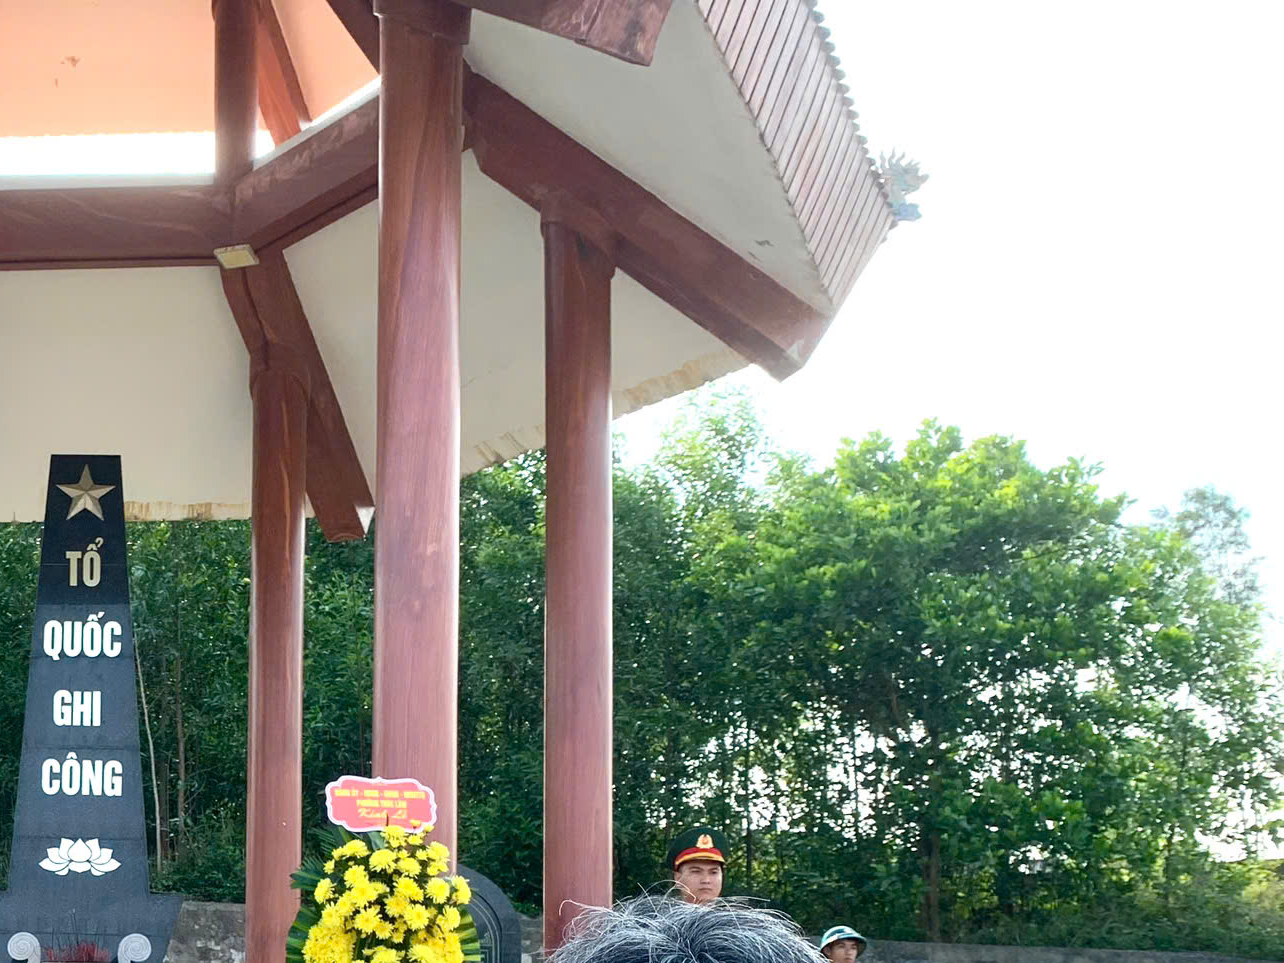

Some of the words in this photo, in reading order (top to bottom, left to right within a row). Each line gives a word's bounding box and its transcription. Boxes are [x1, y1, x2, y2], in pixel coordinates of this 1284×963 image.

[65, 537, 104, 587] TỔ
[43, 611, 122, 661] QUỐC
[53, 689, 102, 727] GHI
[41, 751, 123, 797] CÔNG
